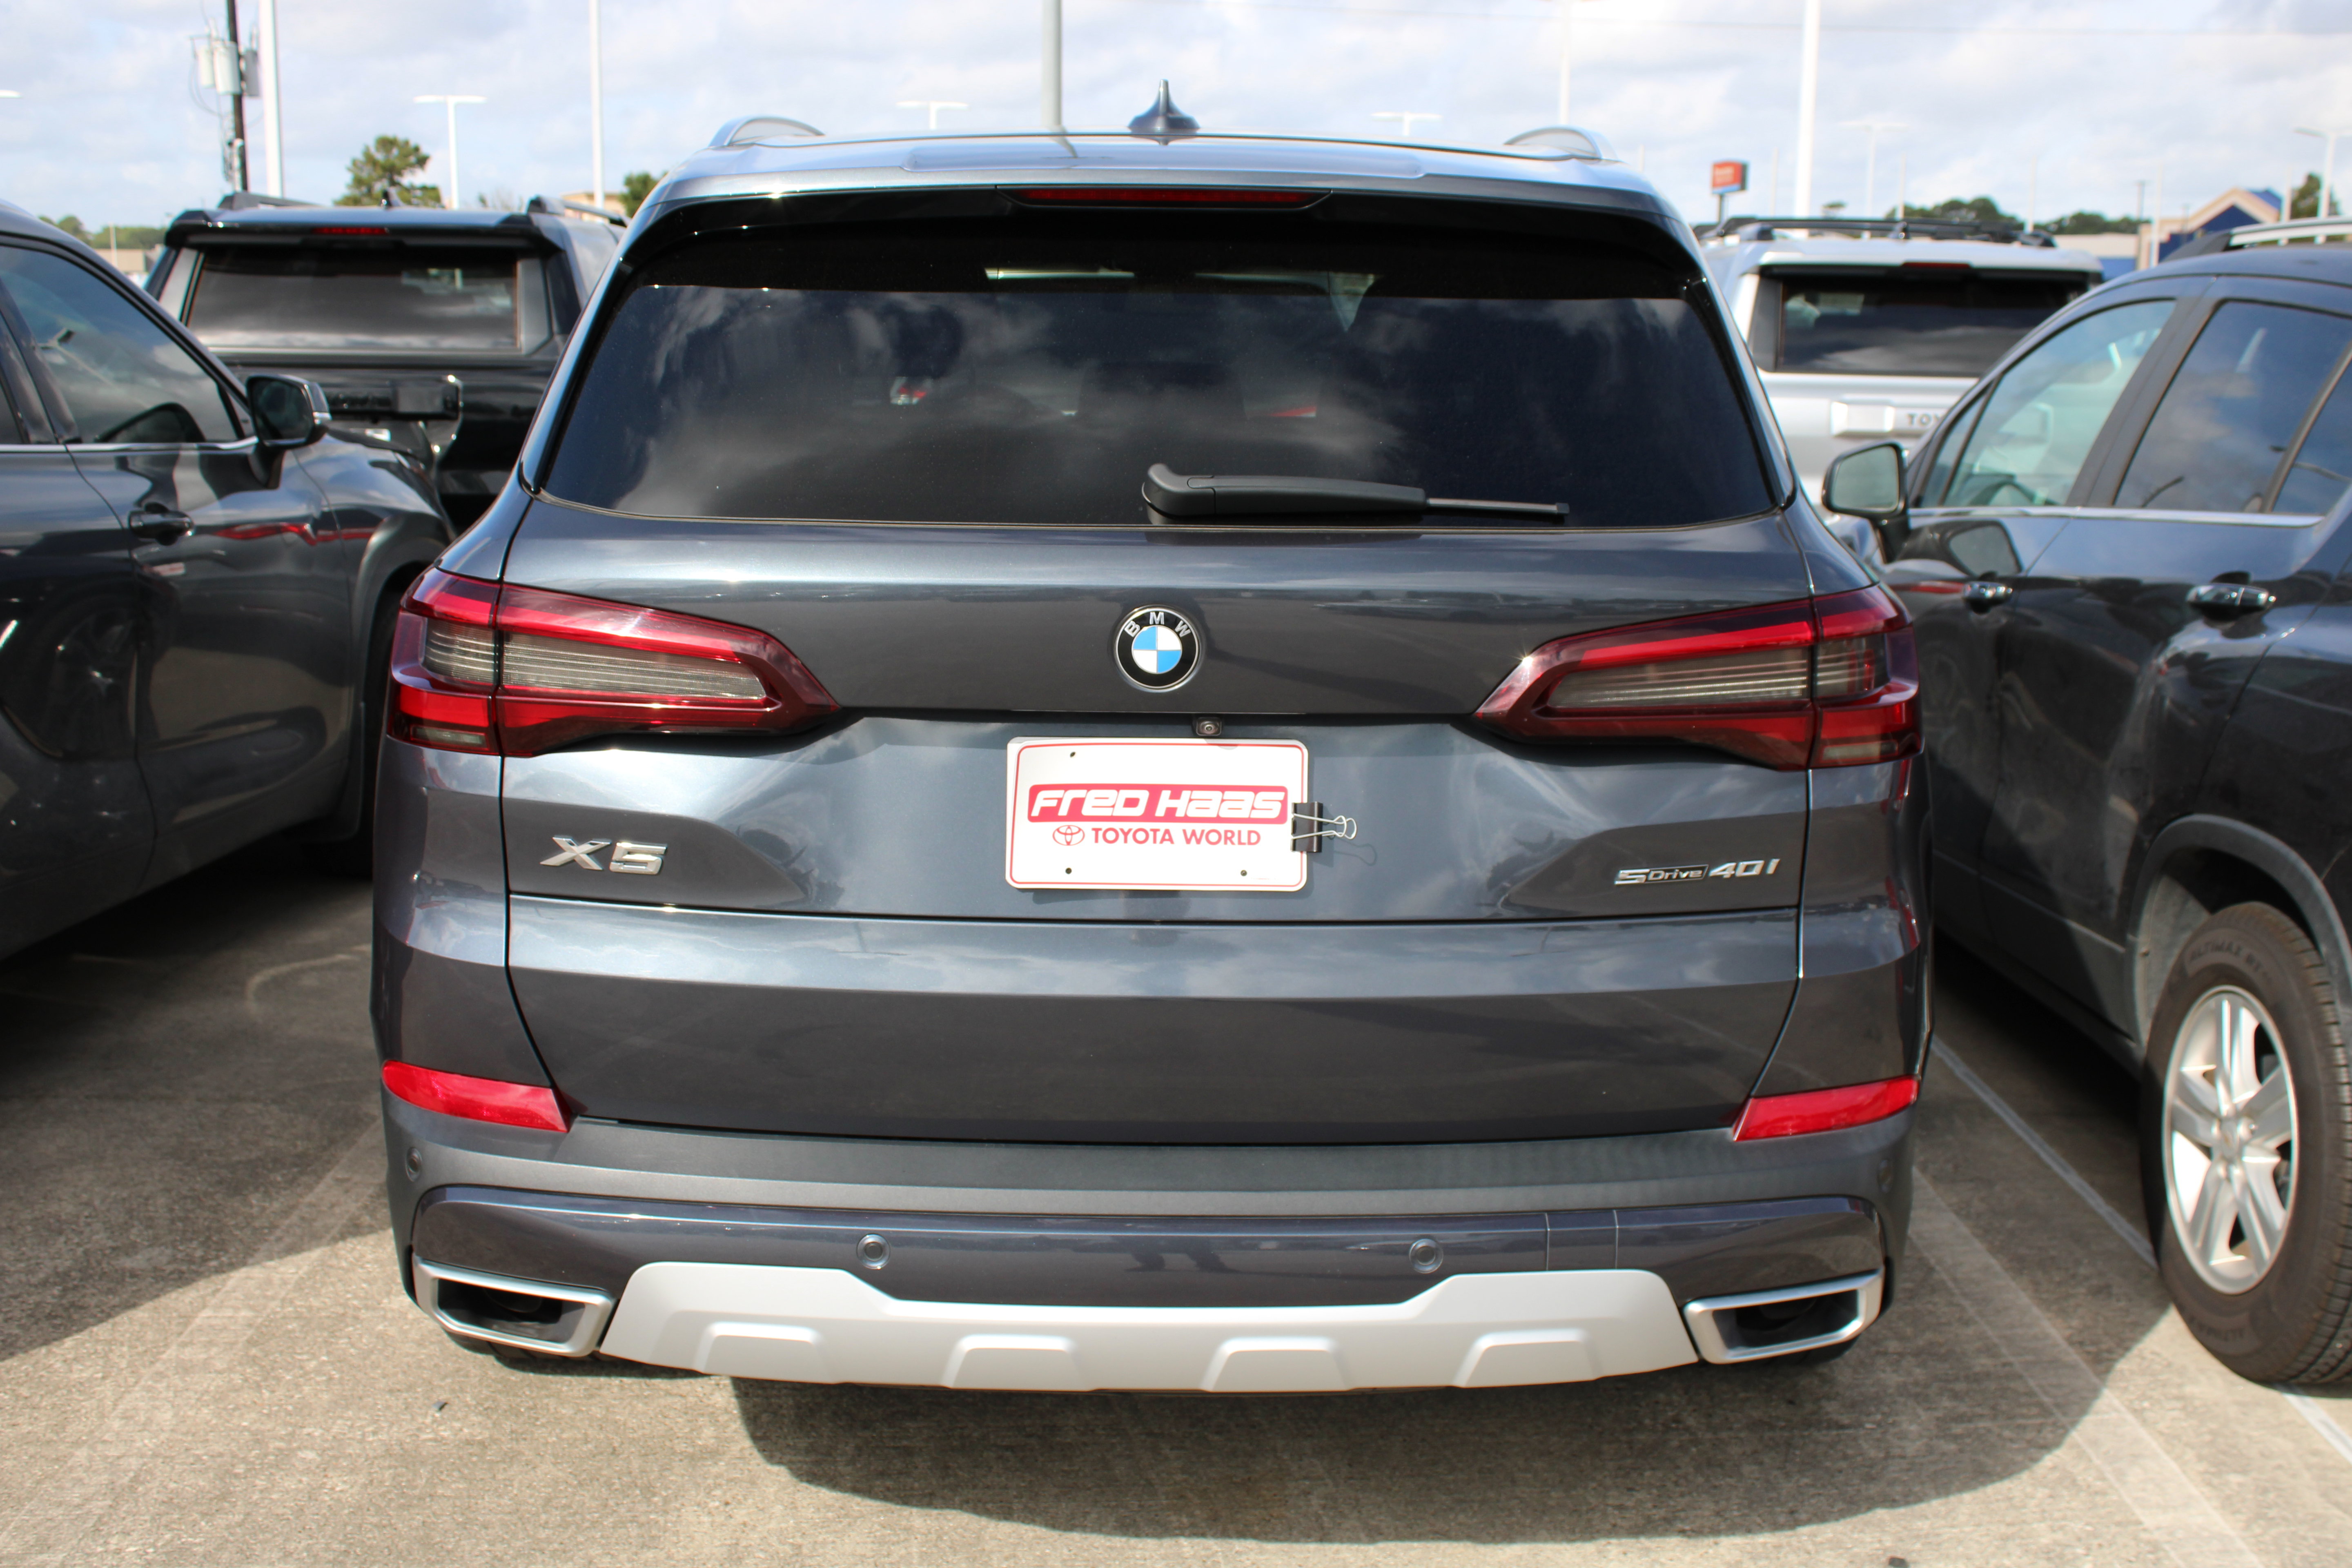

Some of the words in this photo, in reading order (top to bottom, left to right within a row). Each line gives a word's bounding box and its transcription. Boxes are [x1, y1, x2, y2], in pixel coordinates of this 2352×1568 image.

[1124, 611, 1191, 637] BMW
[1091, 827, 1174, 845] TOYOTA
[1182, 829, 1261, 846] WORLD
[539, 836, 667, 875] X5
